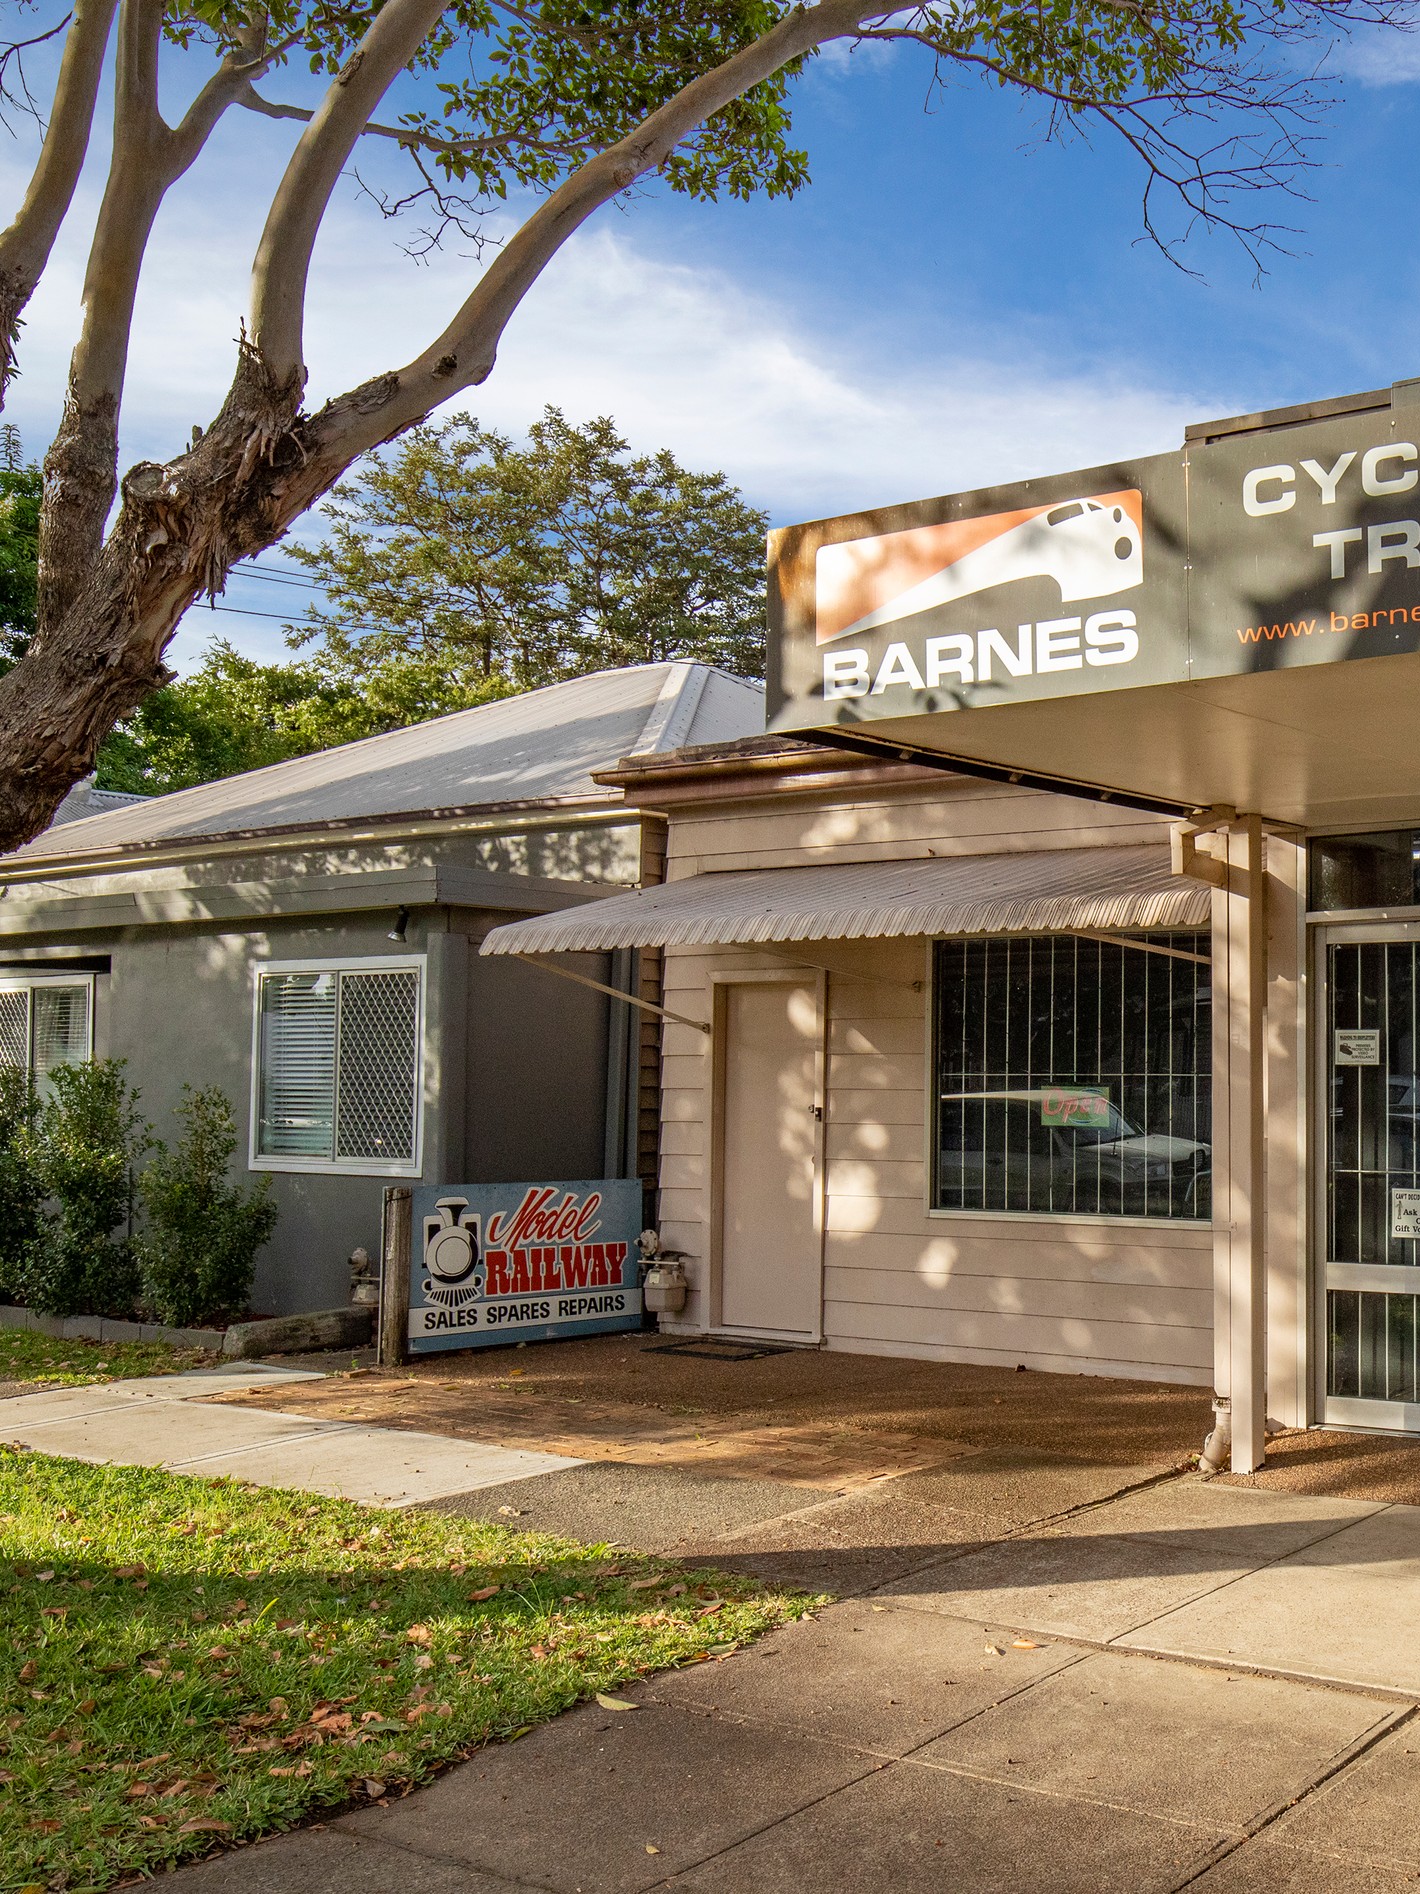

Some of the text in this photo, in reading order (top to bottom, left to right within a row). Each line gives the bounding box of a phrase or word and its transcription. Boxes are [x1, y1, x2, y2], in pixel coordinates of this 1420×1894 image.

[823, 608, 1140, 702] BARNES
[1043, 1088, 1108, 1123] Open
[486, 1187, 602, 1250] Model
[485, 1242, 628, 1296] RAILWAY
[424, 1294, 625, 1330] SALES SPARES REPAIRS
